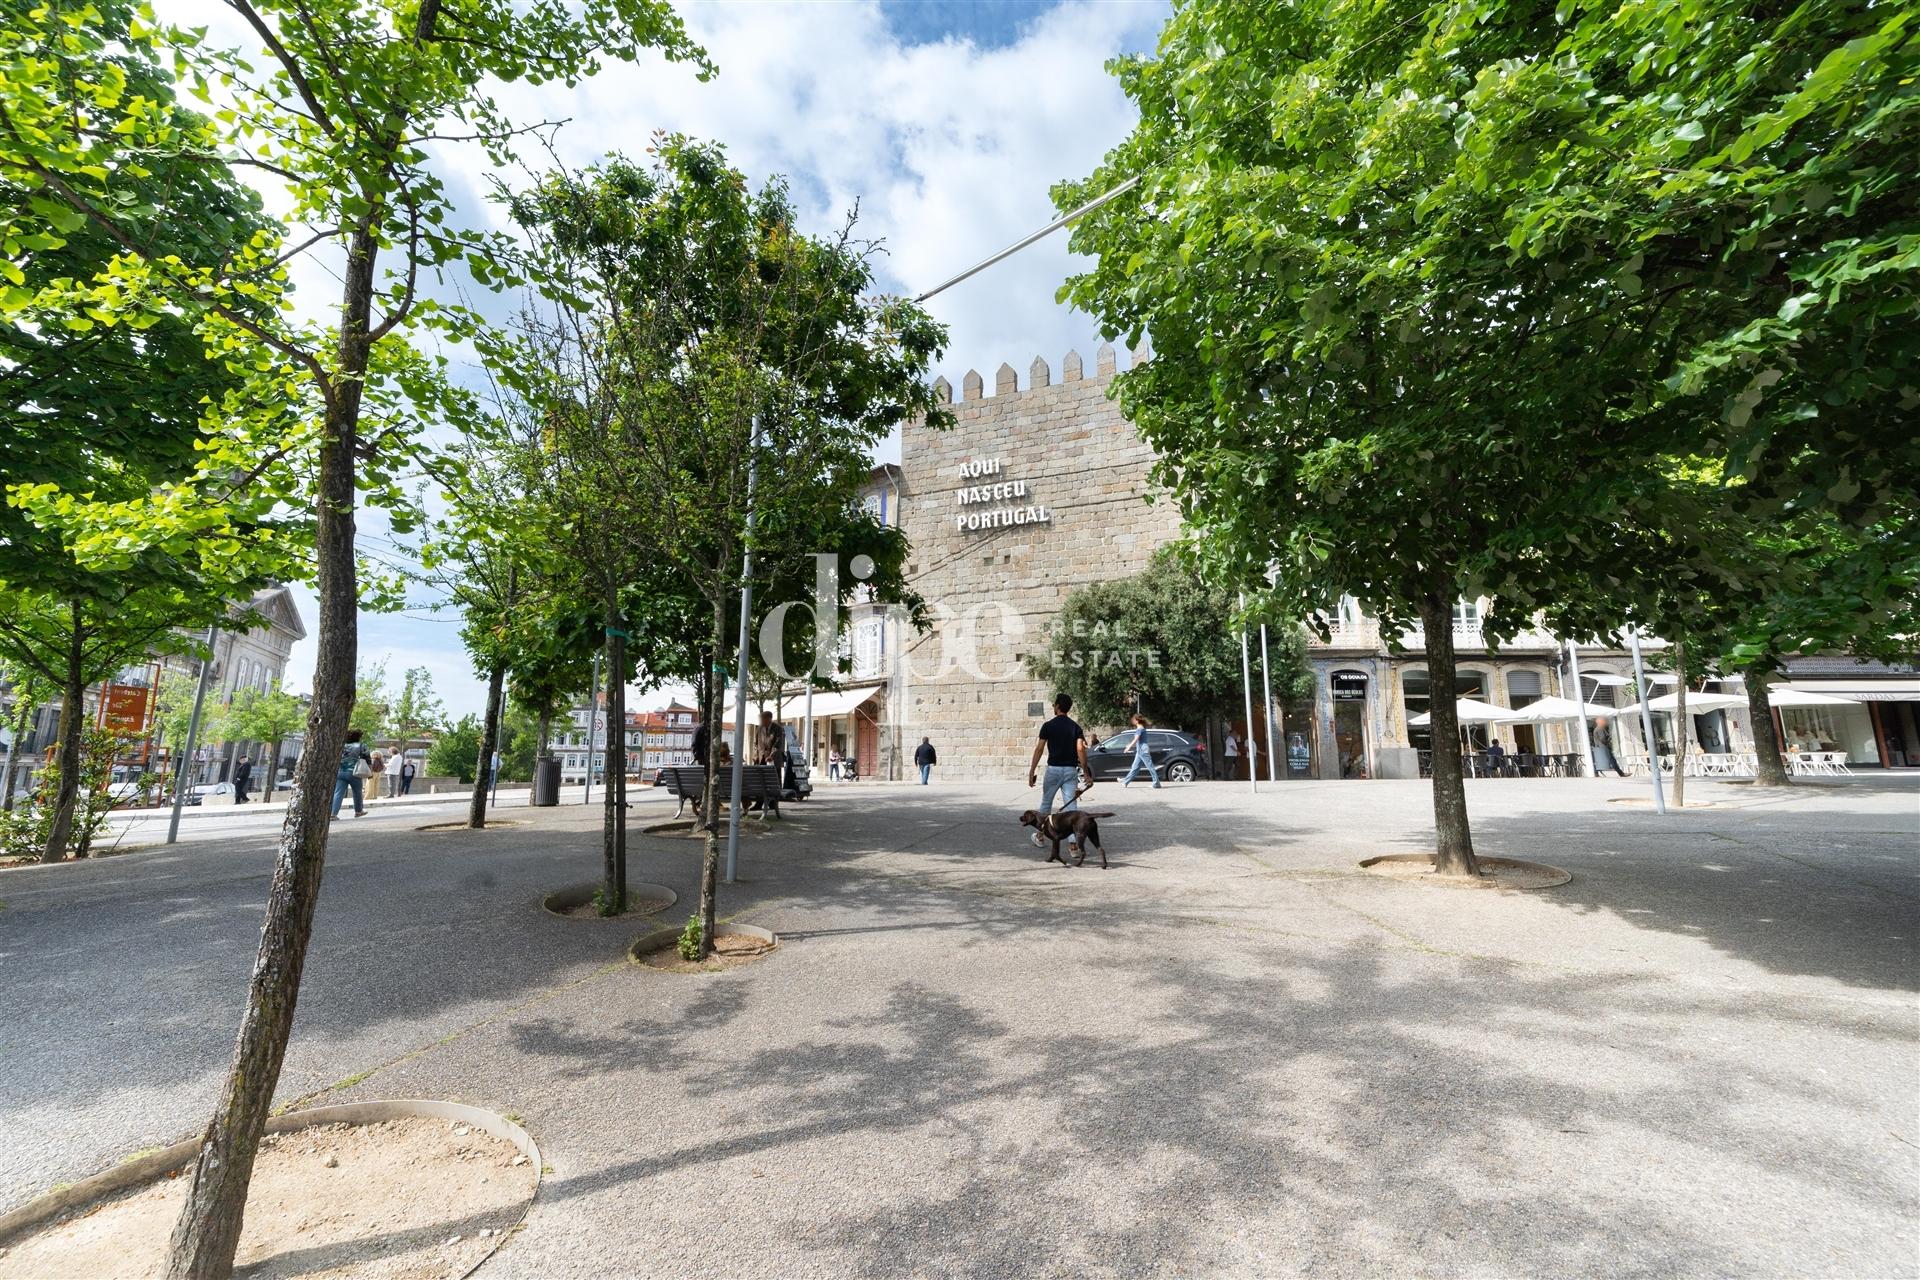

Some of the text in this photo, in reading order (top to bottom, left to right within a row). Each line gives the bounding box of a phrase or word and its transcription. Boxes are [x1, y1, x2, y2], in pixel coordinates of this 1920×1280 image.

[959, 458, 1000, 478] AQUI
[957, 481, 1025, 505] NASCEU
[957, 506, 1050, 531] PORTUGAL
